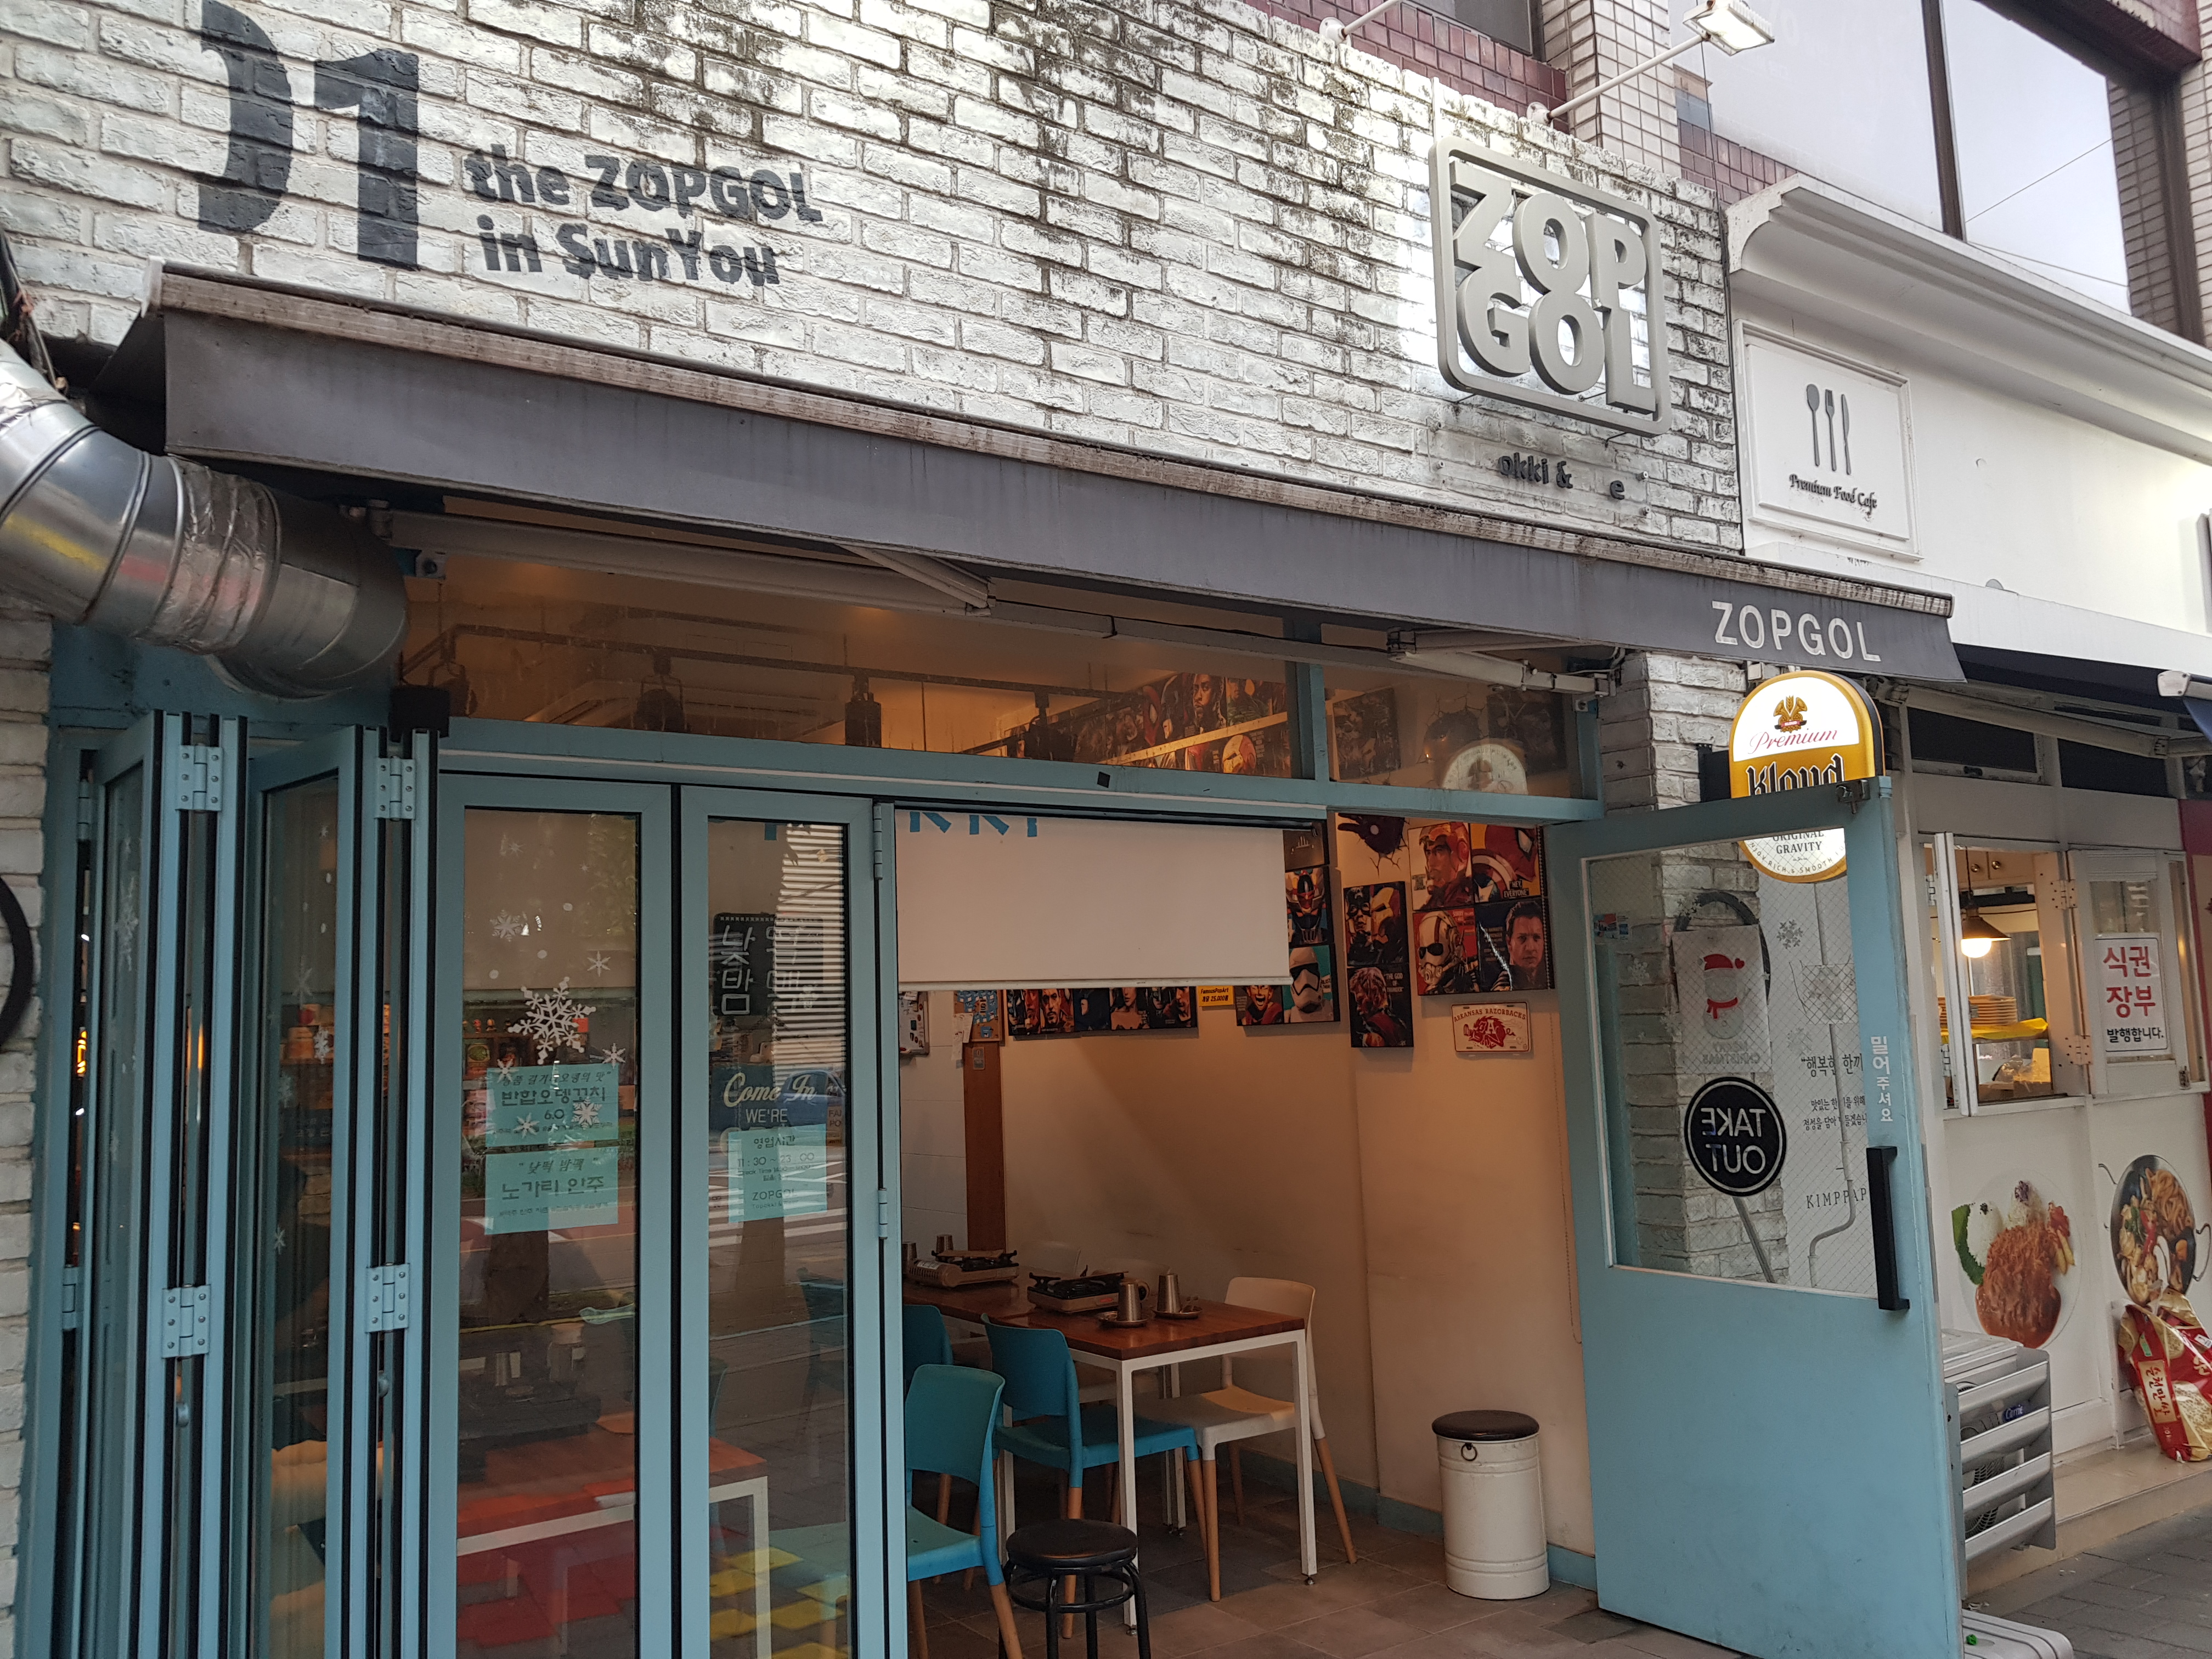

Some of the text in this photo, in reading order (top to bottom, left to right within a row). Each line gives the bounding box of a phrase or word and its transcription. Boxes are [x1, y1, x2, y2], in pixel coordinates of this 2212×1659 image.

[464, 144, 823, 222] the ZOPGOL
[476, 214, 780, 286] in SunYou
[1451, 161, 1647, 313] ZOP
[1457, 268, 1656, 415] GOL
[1789, 473, 1877, 516] Premium Food Cafe
[1711, 600, 1882, 662] ZOPGOL
[1748, 728, 1838, 754] Premium
[1776, 841, 1822, 854] GRAVITY
[2103, 946, 2152, 978] 식권
[1454, 1008, 1526, 1022] ARKANSAS RAZORBACKS
[2106, 986, 2156, 1018] 장부
[2107, 1027, 2164, 1043] 발행합니다.
[724, 1071, 782, 1108] Come
[1811, 1098, 1830, 1112] 맛있는
[746, 1108, 788, 1123] WE'RE
[754, 1135, 795, 1149] 영업시간
[502, 1176, 604, 1200] 노가리 안주
